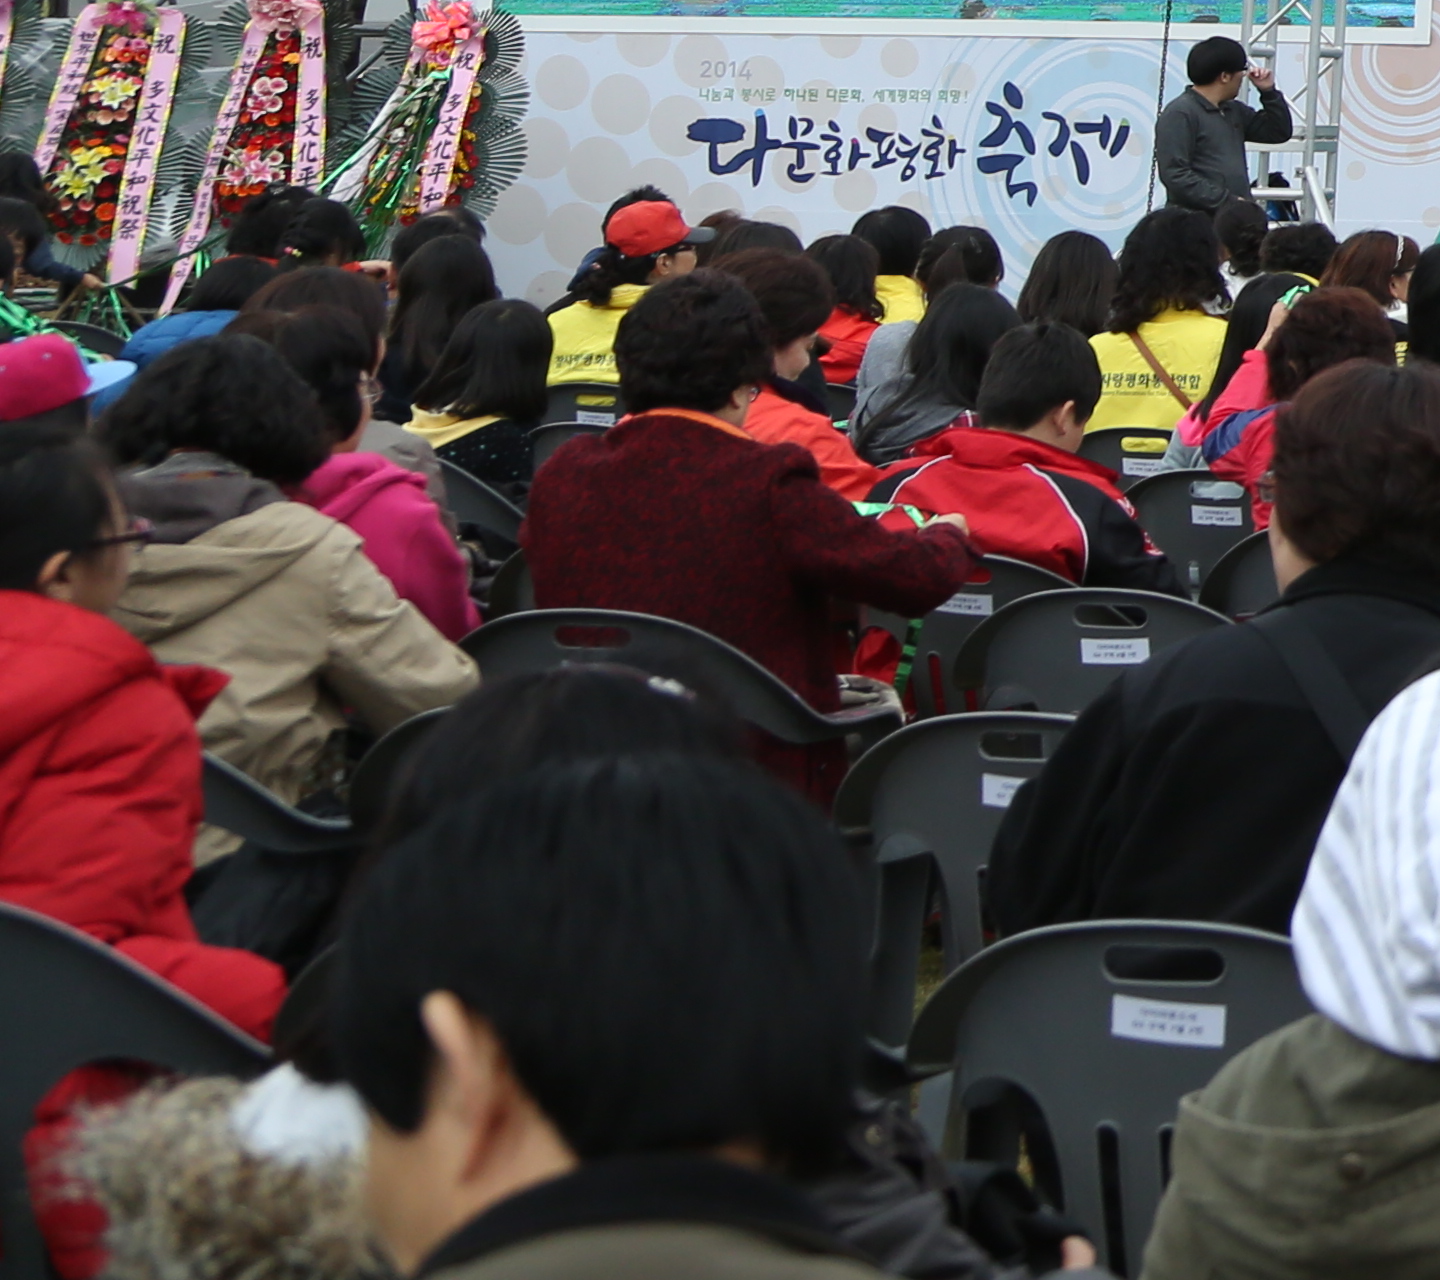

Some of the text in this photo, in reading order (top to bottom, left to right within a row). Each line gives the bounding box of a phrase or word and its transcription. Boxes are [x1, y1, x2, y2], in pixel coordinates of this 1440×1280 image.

[155, 33, 175, 55] 祝
[304, 36, 323, 60] 祝
[454, 50, 475, 71] 祝
[699, 60, 753, 81] 2014
[741, 88, 777, 104] 봉사로
[783, 89, 820, 104] 하나된
[872, 89, 932, 104] 세계평화의
[937, 90, 970, 105] 희망!
[976, 81, 1131, 208] 축제
